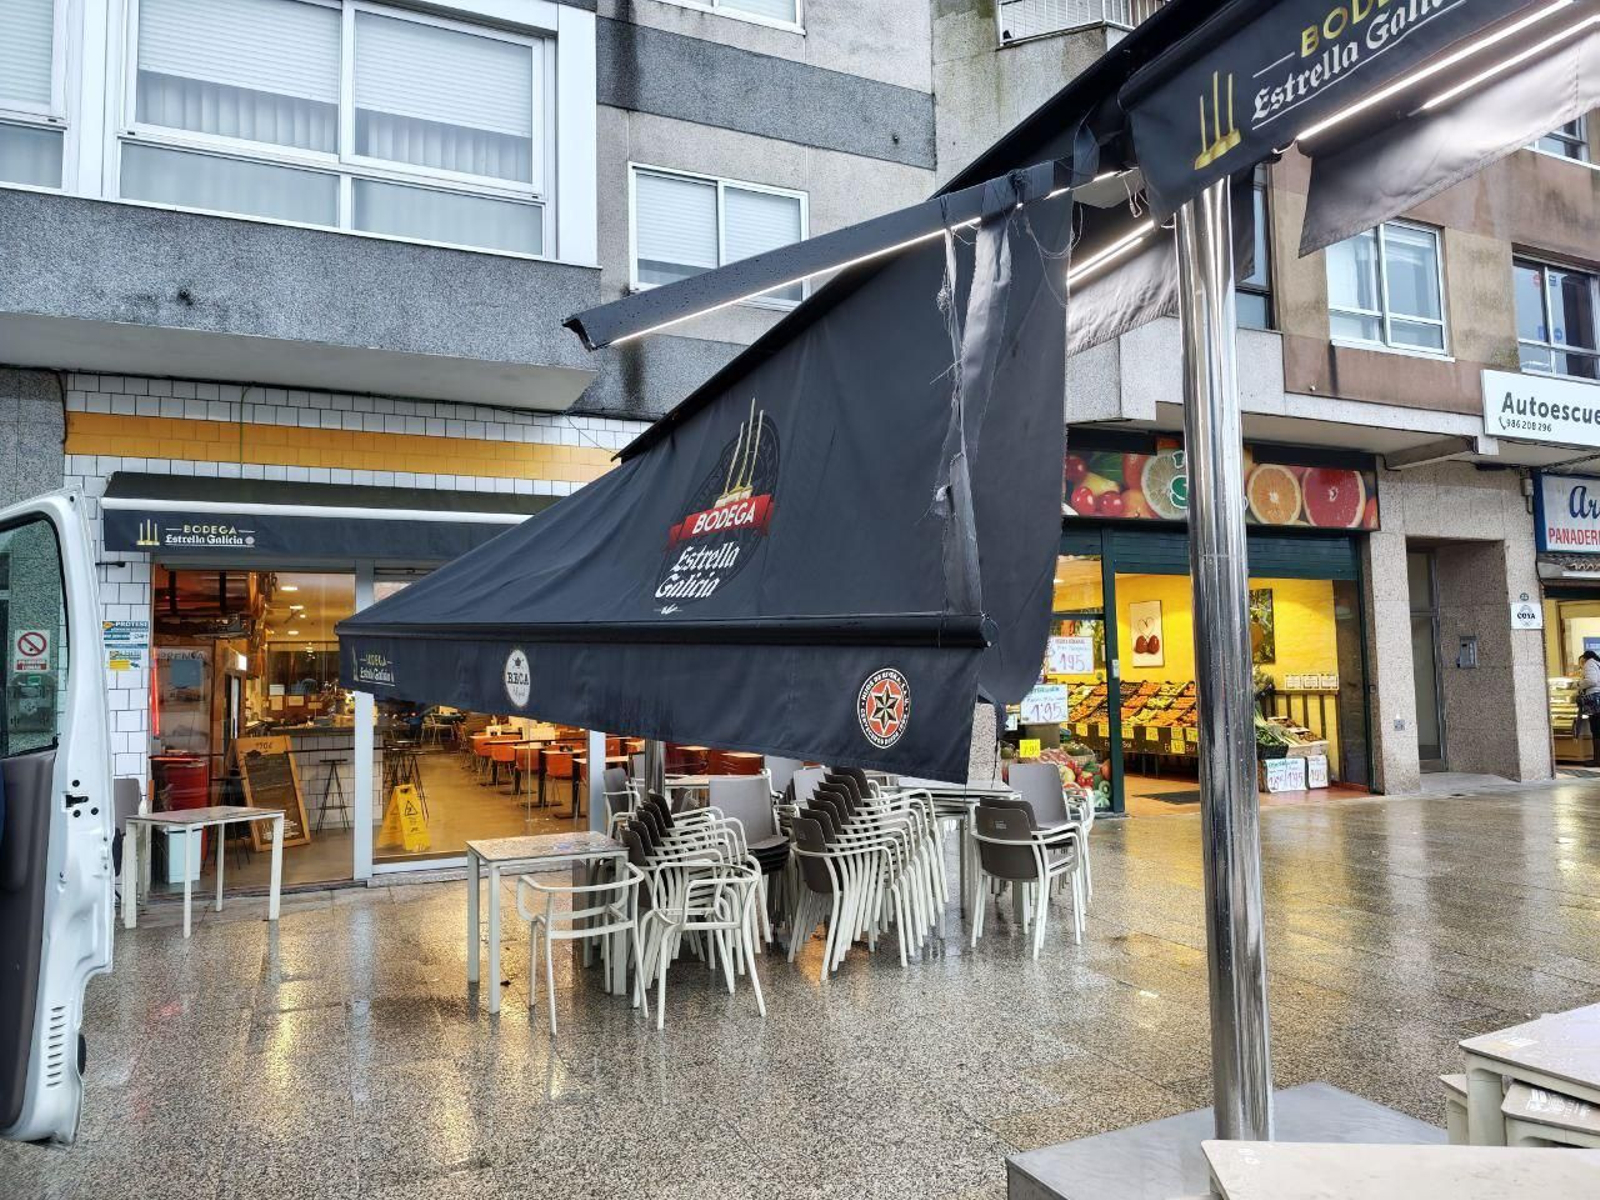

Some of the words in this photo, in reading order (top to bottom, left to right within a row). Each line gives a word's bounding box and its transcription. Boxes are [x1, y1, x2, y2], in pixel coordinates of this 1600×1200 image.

[1252, 40, 1359, 121] Estrella
[1506, 418, 1520, 428] 986
[1538, 422, 1552, 432] 296
[691, 501, 756, 535] BODEGA
[165, 534, 205, 543] Estrella
[207, 535, 243, 545] Galicia
[183, 525, 237, 534] BODEGA
[670, 541, 741, 572] Estrella
[654, 571, 721, 598] Galicia
[1517, 612, 1536, 620] COYA
